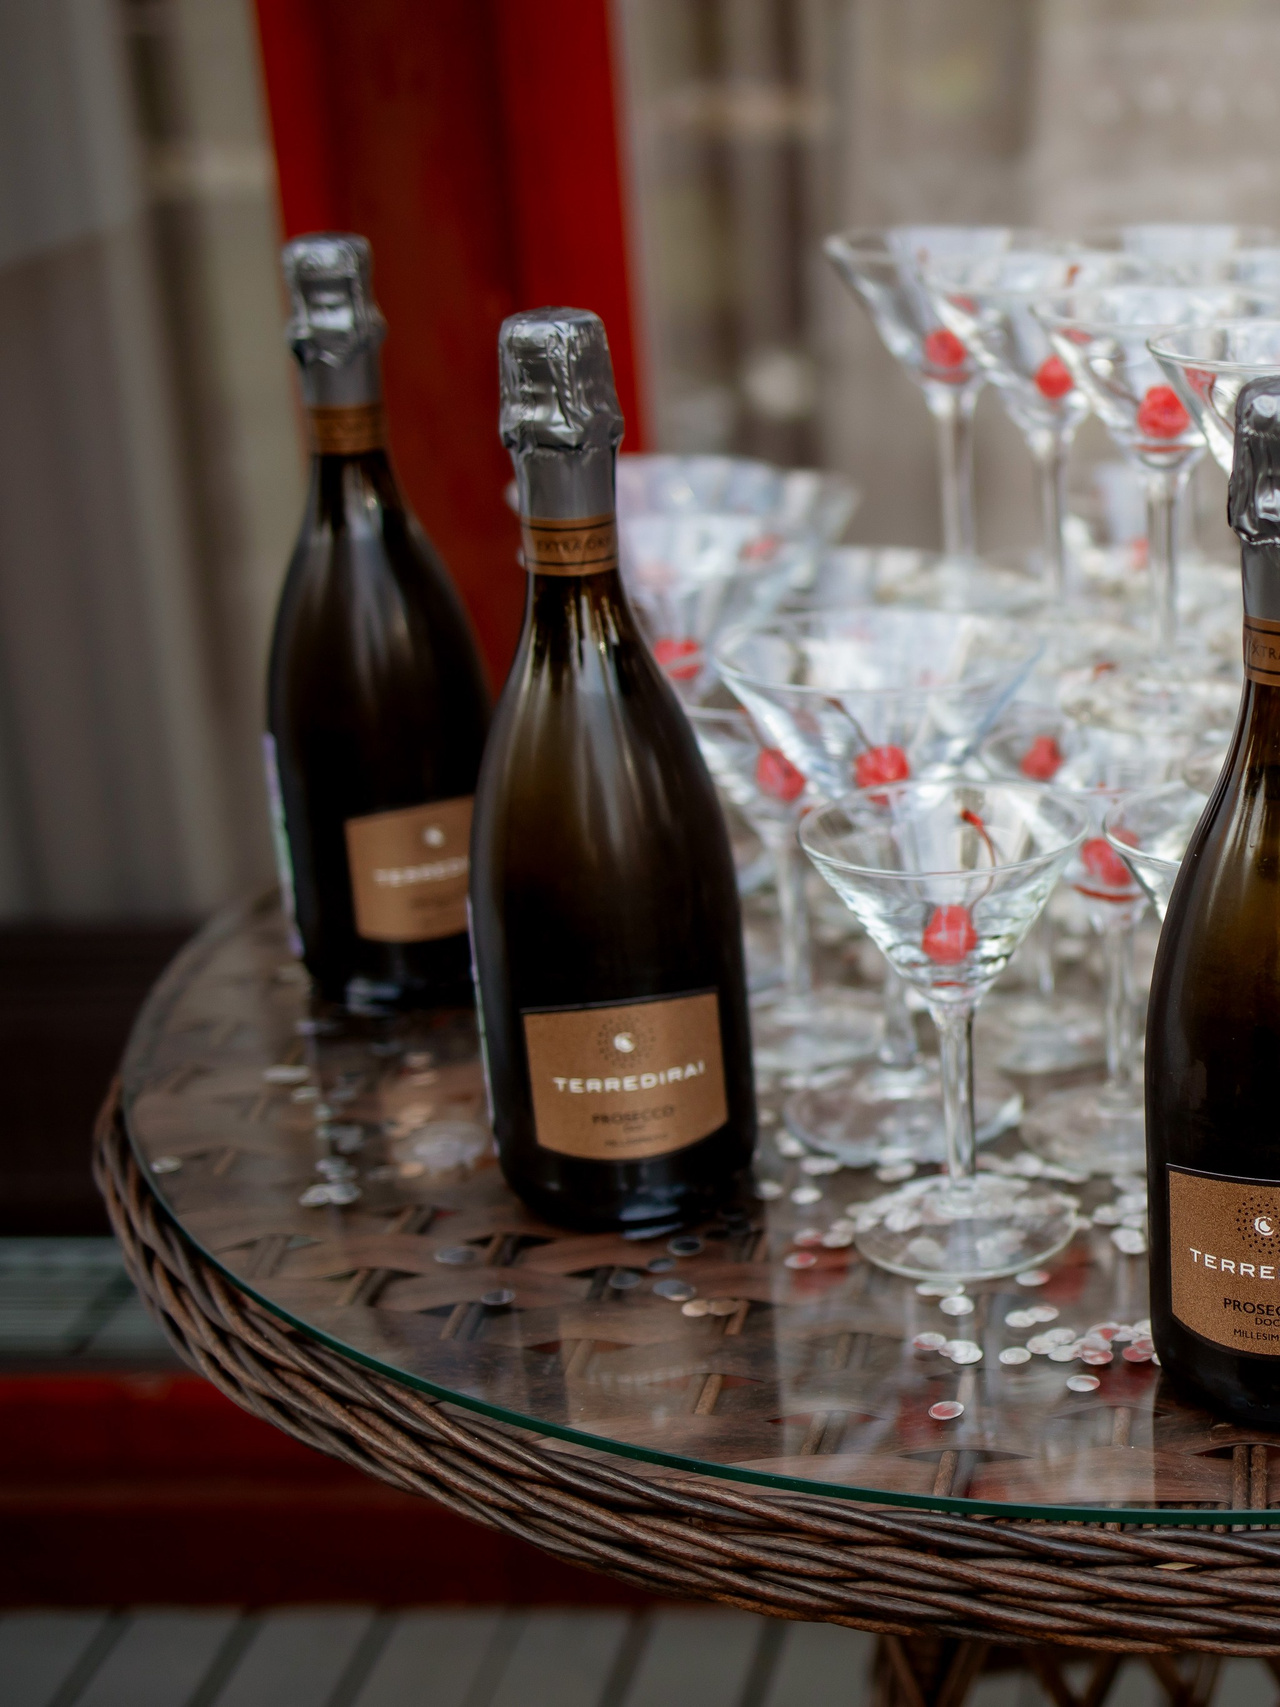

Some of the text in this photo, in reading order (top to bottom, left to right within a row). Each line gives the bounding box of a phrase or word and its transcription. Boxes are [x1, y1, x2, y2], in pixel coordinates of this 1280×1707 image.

[553, 1060, 705, 1094] TERREDIRAI
[592, 1104, 675, 1126] PROSECCO
[1254, 1317, 1280, 1328] DOC
